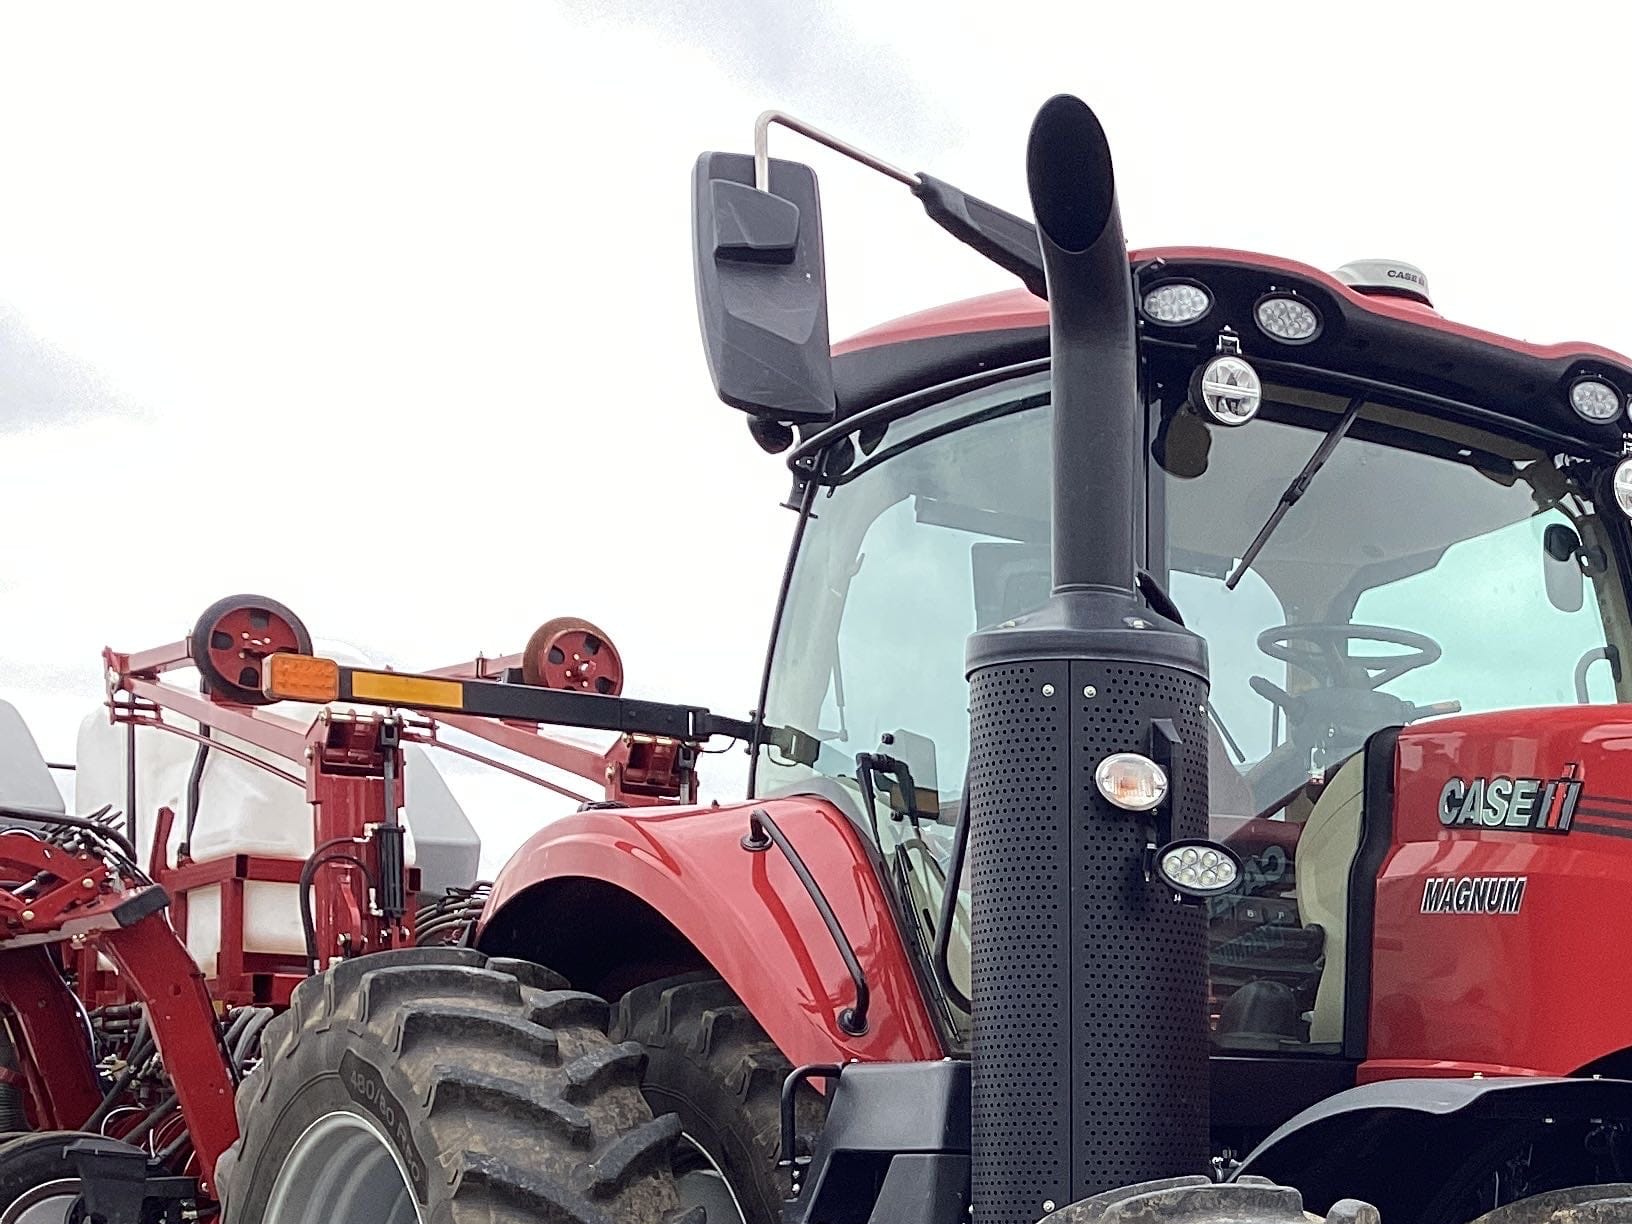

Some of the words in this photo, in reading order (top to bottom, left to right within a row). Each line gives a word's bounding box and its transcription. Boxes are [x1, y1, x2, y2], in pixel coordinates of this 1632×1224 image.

[1387, 270, 1417, 283] CASE
[1438, 776, 1541, 827] CASE
[1420, 876, 1528, 914] MAGNUM
